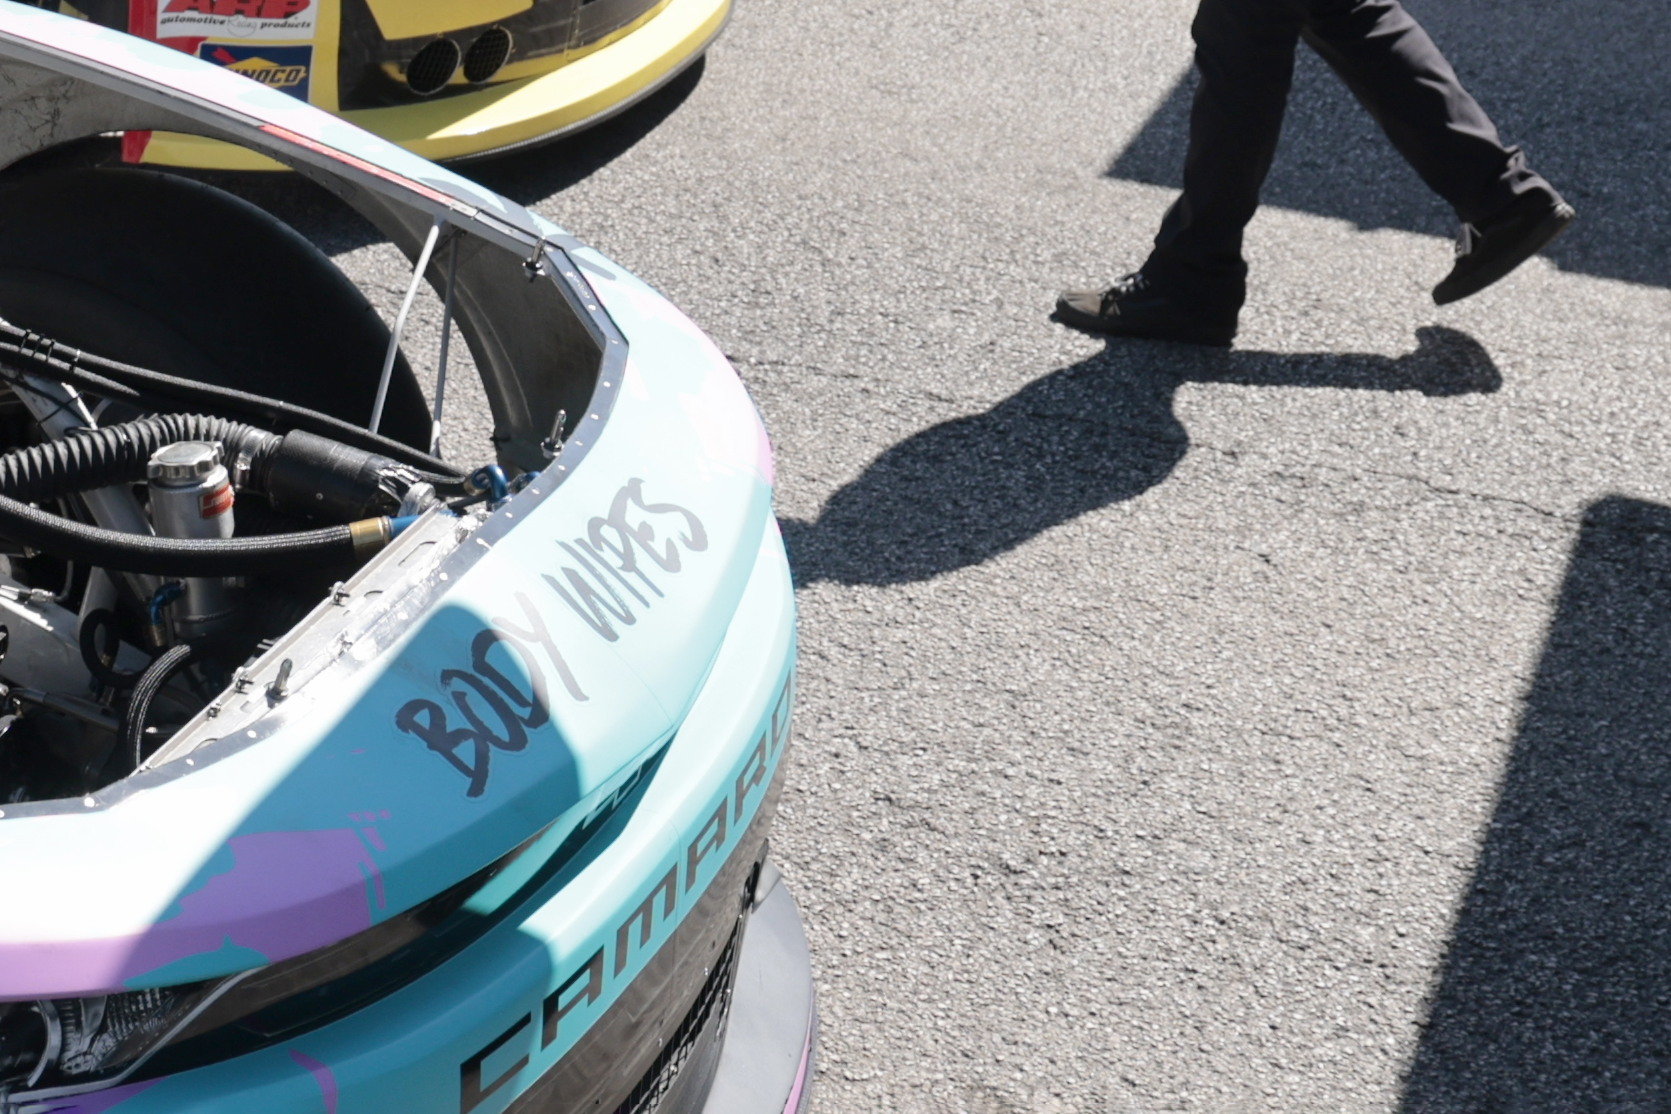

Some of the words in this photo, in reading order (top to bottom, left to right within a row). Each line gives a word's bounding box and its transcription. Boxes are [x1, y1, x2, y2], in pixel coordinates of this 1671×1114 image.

[160, 15, 226, 25] automotive
[259, 20, 312, 30] products
[232, 68, 301, 85] NOCO
[395, 591, 590, 799] BODY
[541, 476, 709, 643] WIPES
[459, 666, 795, 1114] CAMARO
